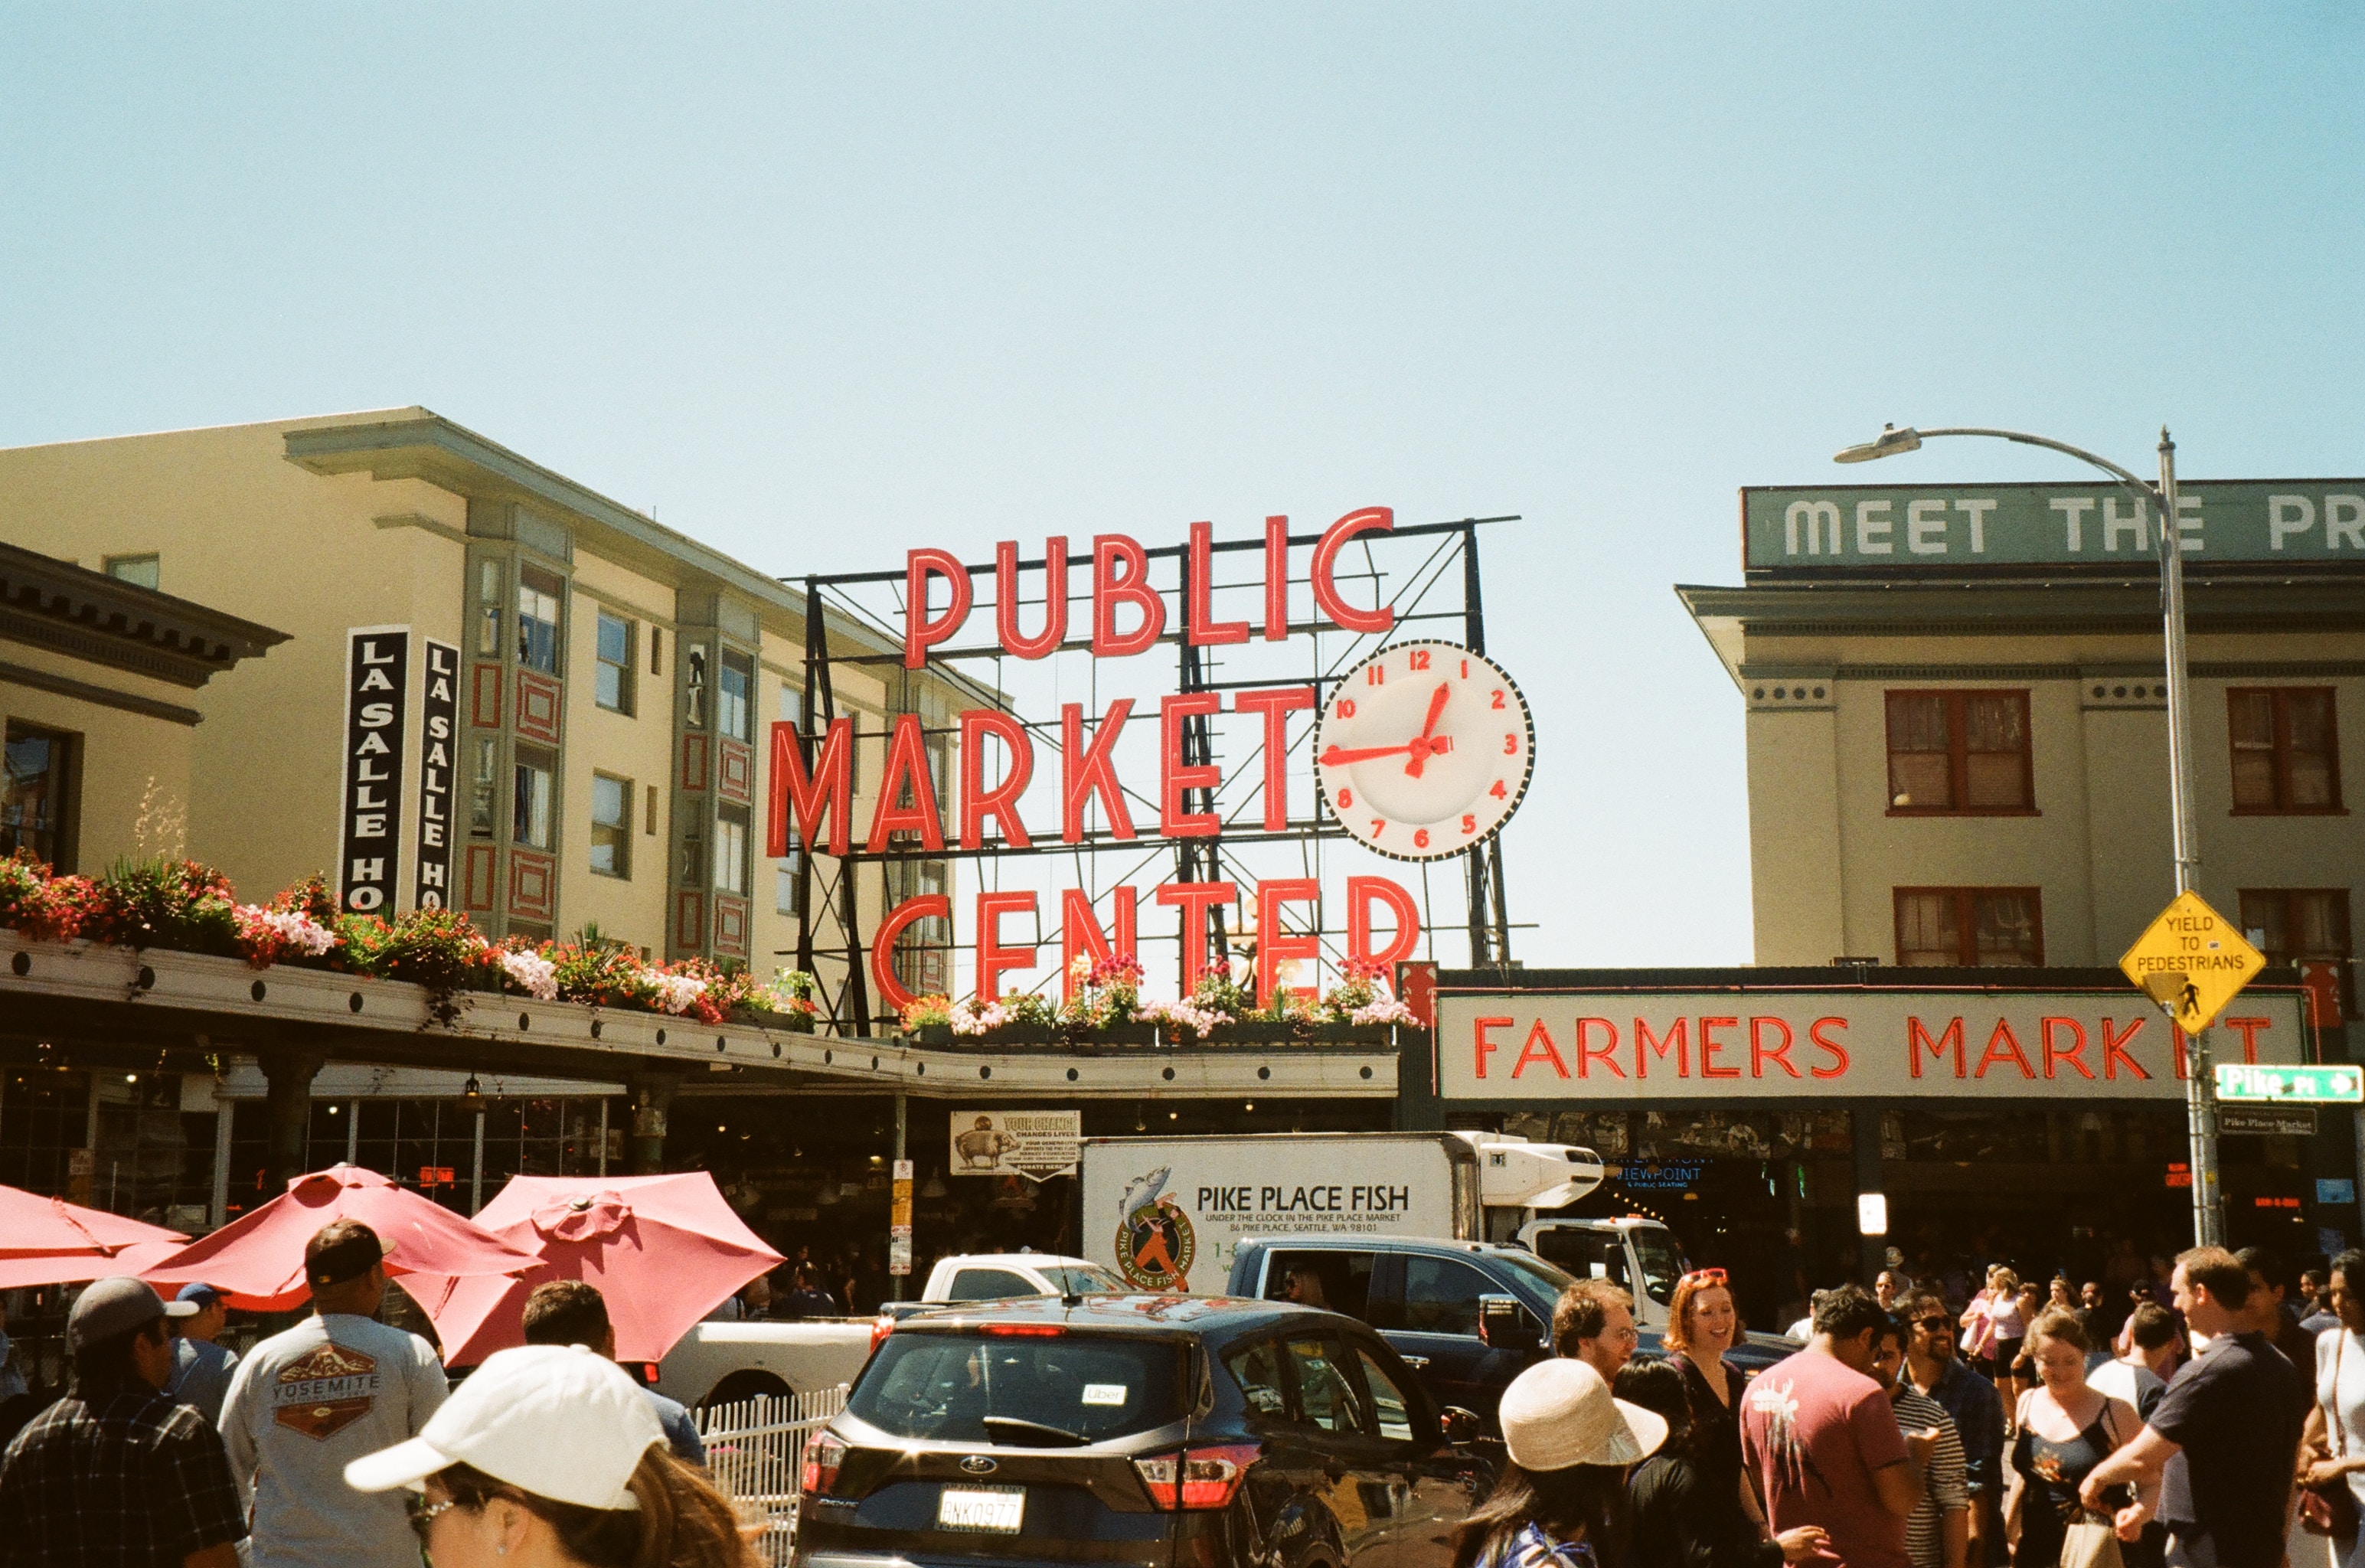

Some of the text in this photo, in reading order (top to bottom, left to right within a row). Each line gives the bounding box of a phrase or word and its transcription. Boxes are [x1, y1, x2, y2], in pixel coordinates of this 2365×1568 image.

[1784, 498, 1998, 556] MEET
[2049, 495, 2205, 552] THE
[905, 506, 1393, 670] PUBLIC
[359, 641, 394, 691] LA
[1409, 650, 1430, 671] 12
[1461, 659, 1468, 679] 1
[430, 649, 451, 703] LA
[1367, 665, 1383, 686] 11
[1337, 699, 1356, 719] 10
[1491, 690, 1505, 710] 2
[1503, 733, 1518, 755] 3
[355, 702, 394, 838] SALLE
[766, 687, 1318, 858] MARKET
[423, 715, 449, 848] SALLE
[1489, 779, 1507, 800] 4
[1338, 789, 1353, 808] 8
[1371, 819, 1386, 838] 7
[1461, 815, 1476, 834] 5
[1414, 828, 1429, 849] 6
[2166, 916, 2213, 932] YIELD
[872, 875, 1421, 1012] CENTER
[2180, 936, 2200, 951] TO
[2138, 955, 2245, 972] PEDESTRIANS
[1475, 1017, 1851, 1080] FARMERS
[2226, 1068, 2315, 1095] Pike Pl
[1004, 1116, 1078, 1132] YOUR CHANGE
[2224, 1117, 2312, 1130] Pike Place Market
[1197, 1186, 1409, 1211] PIKE PLACE FISH
[1205, 1214, 1400, 1222] UNDER THE CLOCK IN THE PIKE PLACE MARKET
[1230, 1223, 1240, 1232] 86
[1243, 1223, 1260, 1232] PIKE
[1294, 1223, 1328, 1233] SEATTLE,
[1332, 1223, 1347, 1232] WA
[1351, 1223, 1377, 1232] 98101
[1119, 1222, 1192, 1286] PIKE PLACE FISH MARKET
[273, 1375, 381, 1399] YOSEMITE
[1087, 1388, 1120, 1400] Uber
